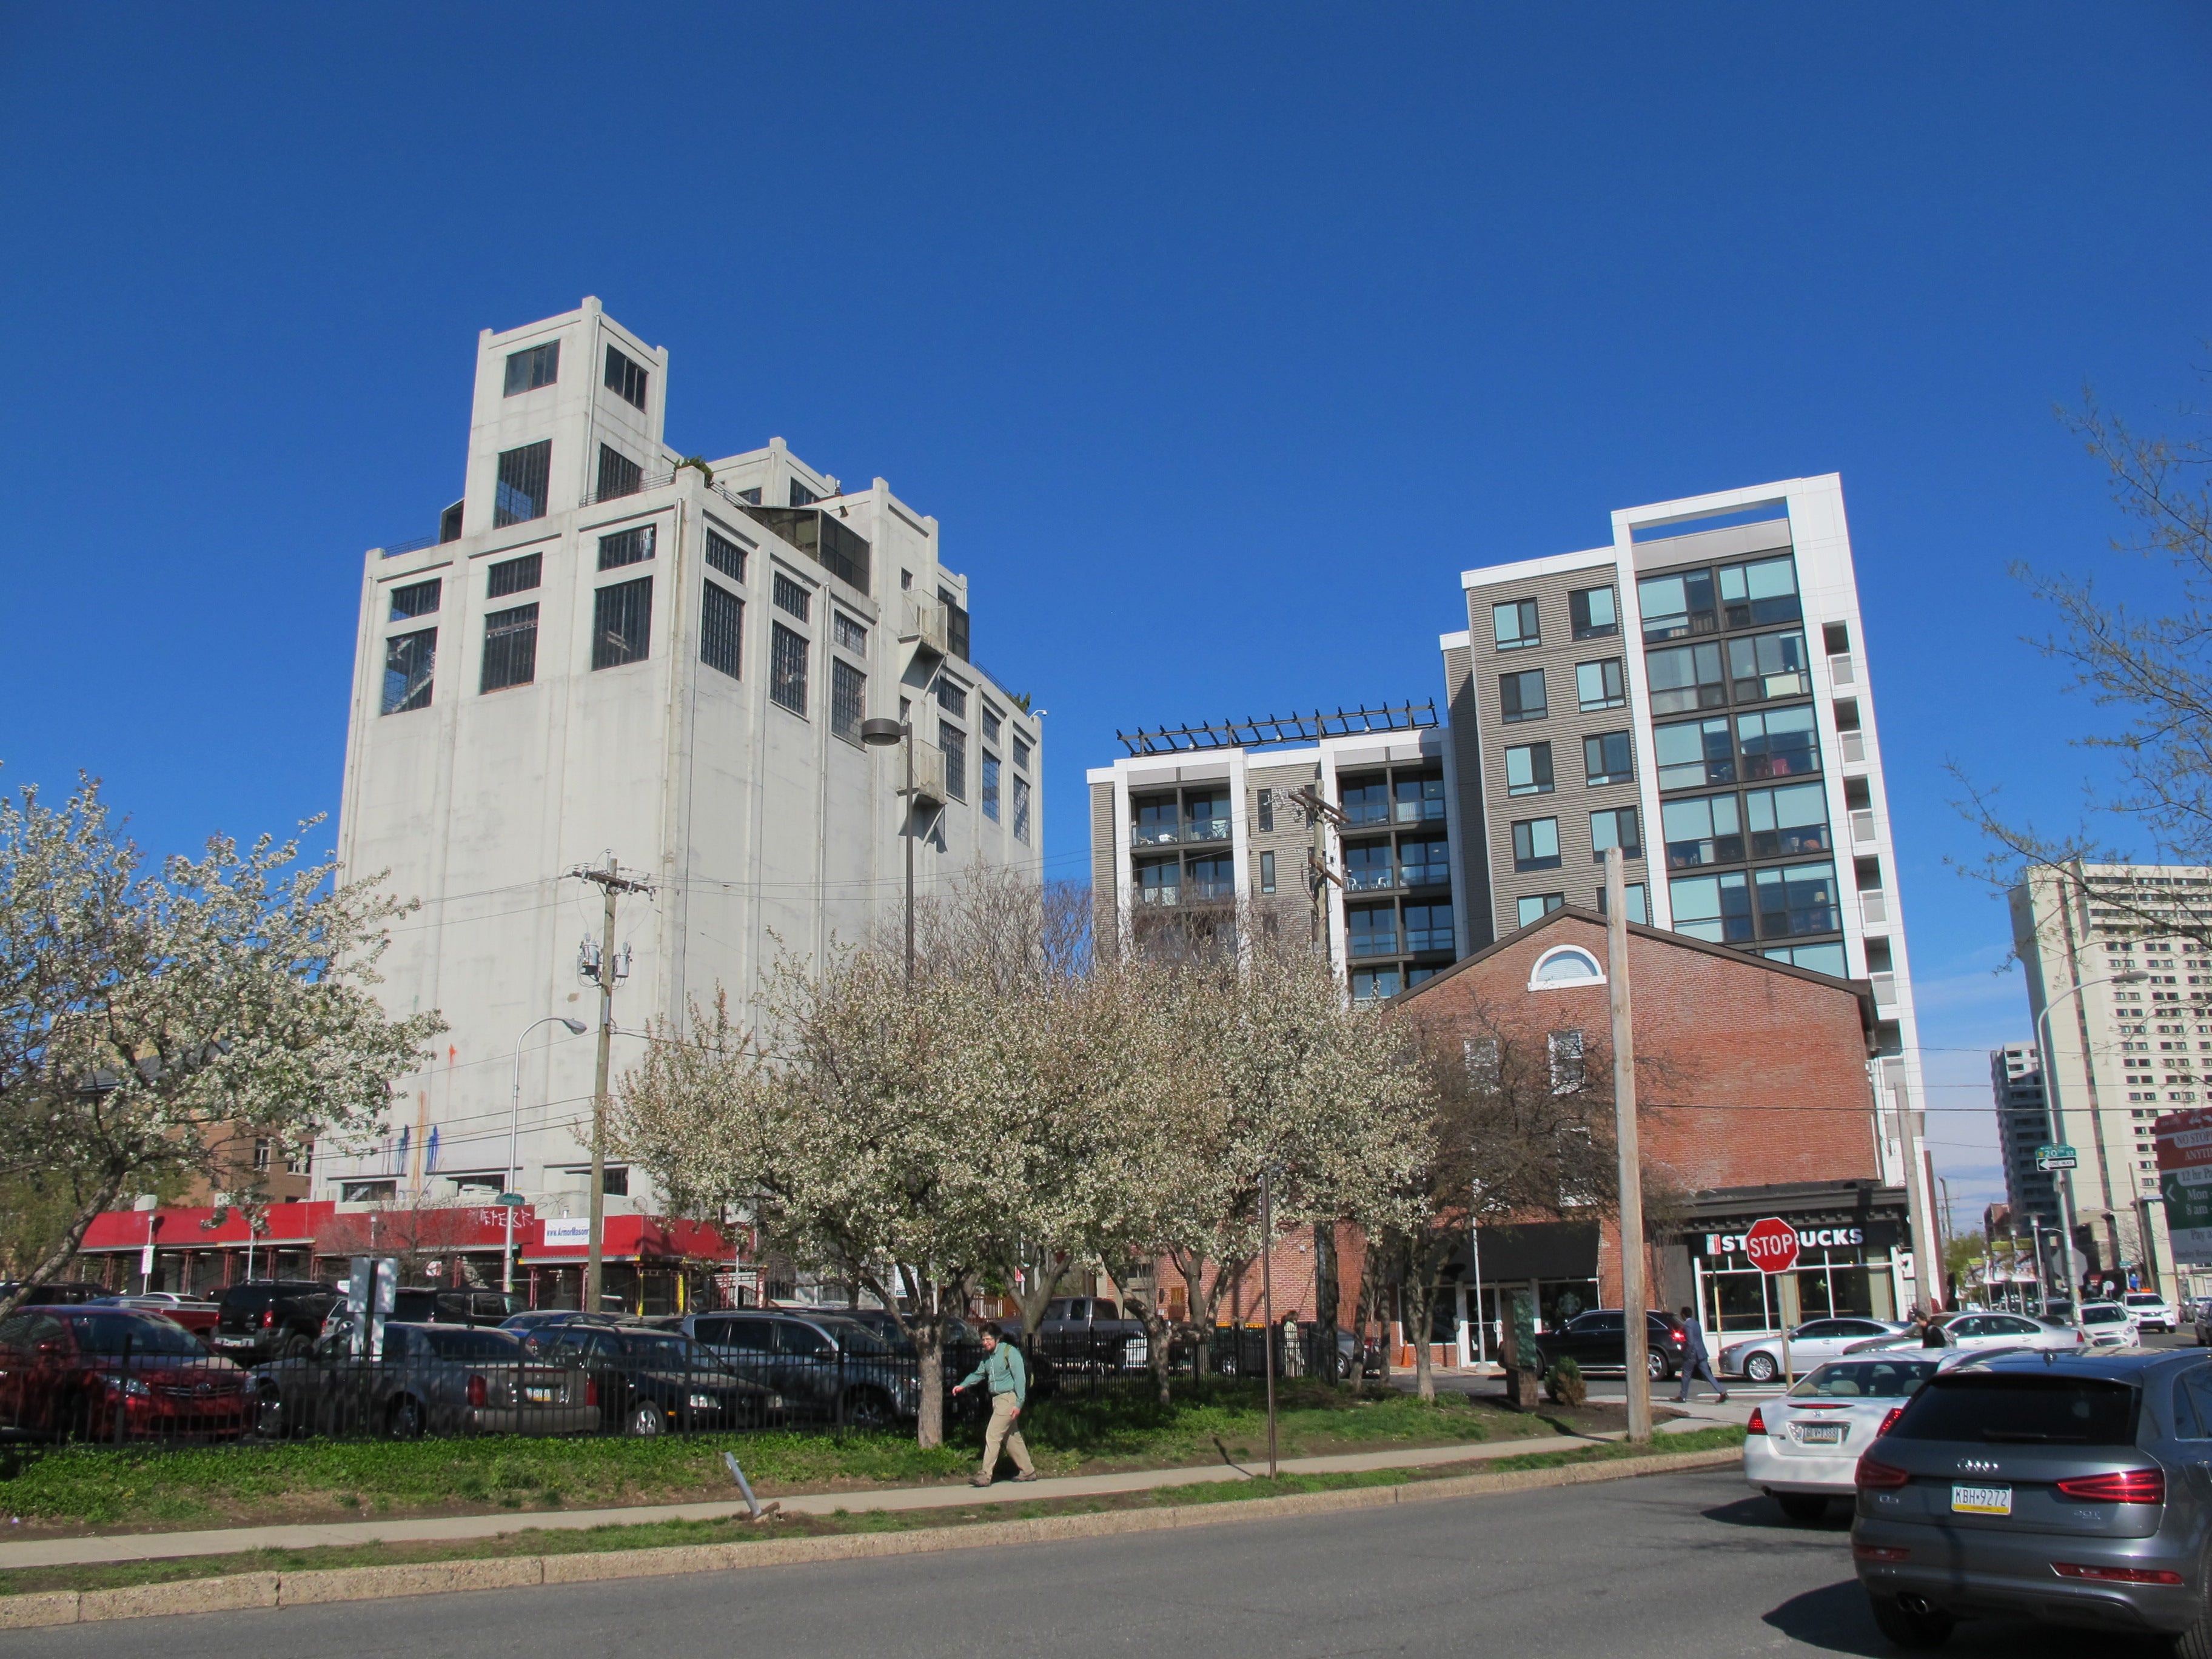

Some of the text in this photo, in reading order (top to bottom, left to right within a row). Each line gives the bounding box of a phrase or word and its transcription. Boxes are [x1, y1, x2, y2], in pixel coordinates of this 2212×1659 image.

[2177, 1134, 2189, 1145] NO
[2182, 1171, 2190, 1181] 12
[2193, 1169, 2202, 1179] hr
[2187, 1189, 2208, 1201] Mon
[2186, 1204, 2208, 1215] 8 am
[1721, 1228, 1863, 1252] STUCKS
[2190, 1229, 2205, 1242] Pay
[1749, 1233, 1793, 1258] STOP
